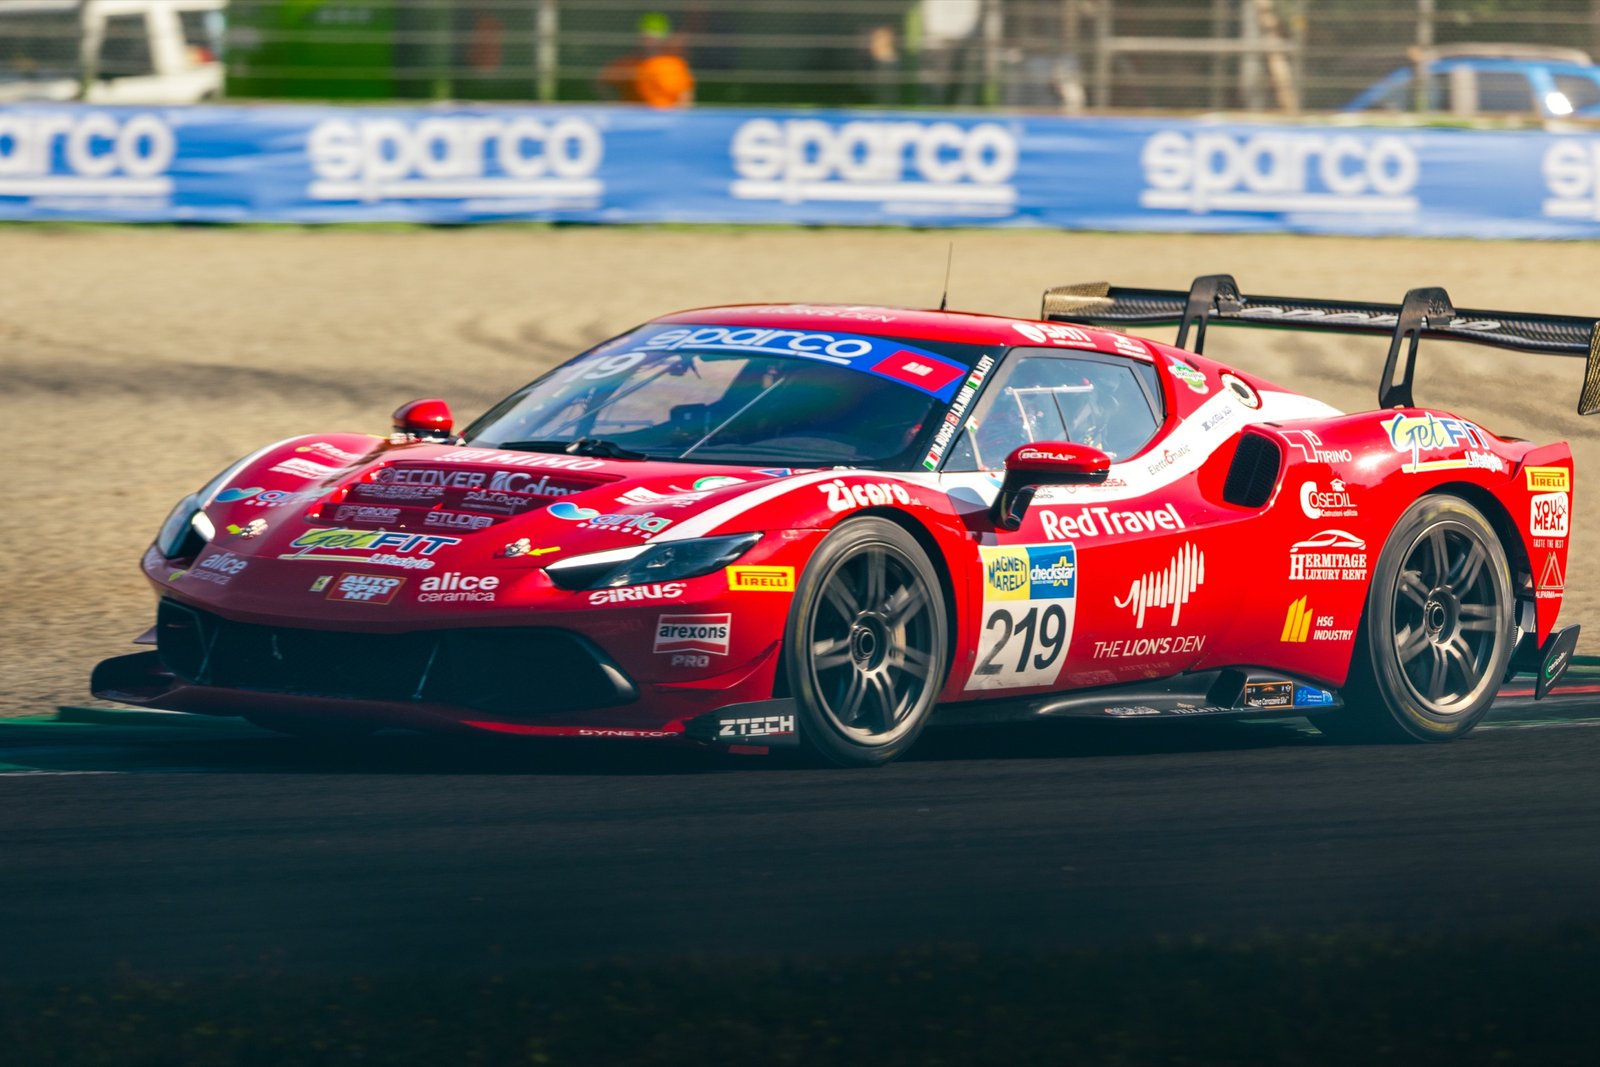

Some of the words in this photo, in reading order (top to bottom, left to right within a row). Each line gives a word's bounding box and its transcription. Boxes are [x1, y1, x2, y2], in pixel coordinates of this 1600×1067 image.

[309, 117, 602, 200] sparco
[731, 118, 1018, 203] sparco
[1142, 130, 1419, 212] sparco
[646, 327, 872, 358] sparco
[1530, 472, 1566, 487] PIRELLI
[1031, 564, 1075, 581] checkstar
[1288, 554, 1367, 580] HERMITAGE
[1305, 569, 1341, 580] LUXURY
[1342, 569, 1367, 580] RENT
[340, 575, 401, 587] AUTO
[419, 572, 500, 591] alice
[735, 571, 788, 587] PIRELLI
[417, 589, 496, 602] ceramica
[1316, 616, 1334, 627] HSG
[659, 625, 727, 639] arexons
[974, 604, 1066, 675] 219
[1313, 629, 1353, 640] INDUSTRY
[1093, 640, 1123, 659] THE
[1122, 637, 1172, 656] LION'S
[1171, 635, 1206, 653] DEN
[671, 655, 710, 667] PRO
[719, 715, 794, 736] ZTECH
